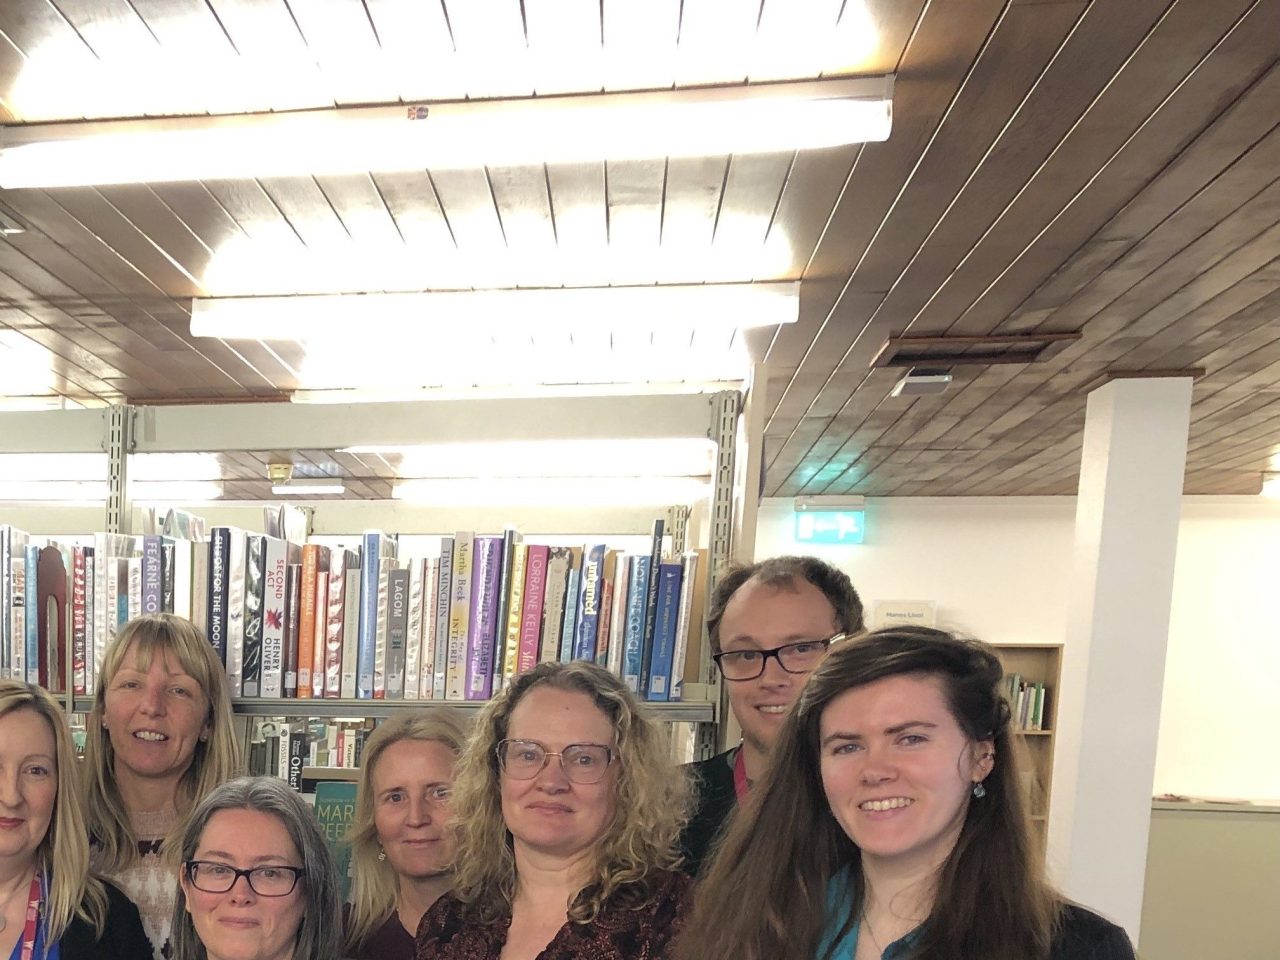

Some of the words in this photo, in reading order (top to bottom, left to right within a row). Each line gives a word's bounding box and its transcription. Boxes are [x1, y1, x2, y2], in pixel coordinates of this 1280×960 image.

[147, 543, 158, 589] FEARNE
[442, 549, 450, 568] TIM
[458, 542, 468, 576] Martha
[634, 558, 645, 582] NOT
[213, 573, 222, 592] FOR
[267, 570, 275, 588] ACT
[275, 559, 284, 600] SECOND
[439, 572, 449, 617] MINCHIN
[456, 579, 466, 602] Beck
[527, 554, 542, 610] LORRAINE
[213, 596, 221, 613] THE
[393, 579, 403, 617] LAGOM
[211, 615, 221, 649] MOON
[449, 618, 459, 672] INTEGRITY
[524, 614, 536, 647] KELLY
[627, 617, 640, 655] COACH
[264, 637, 272, 671] OLIVER
[272, 638, 280, 670] HENRY
[280, 741, 288, 765] FOSSILS
